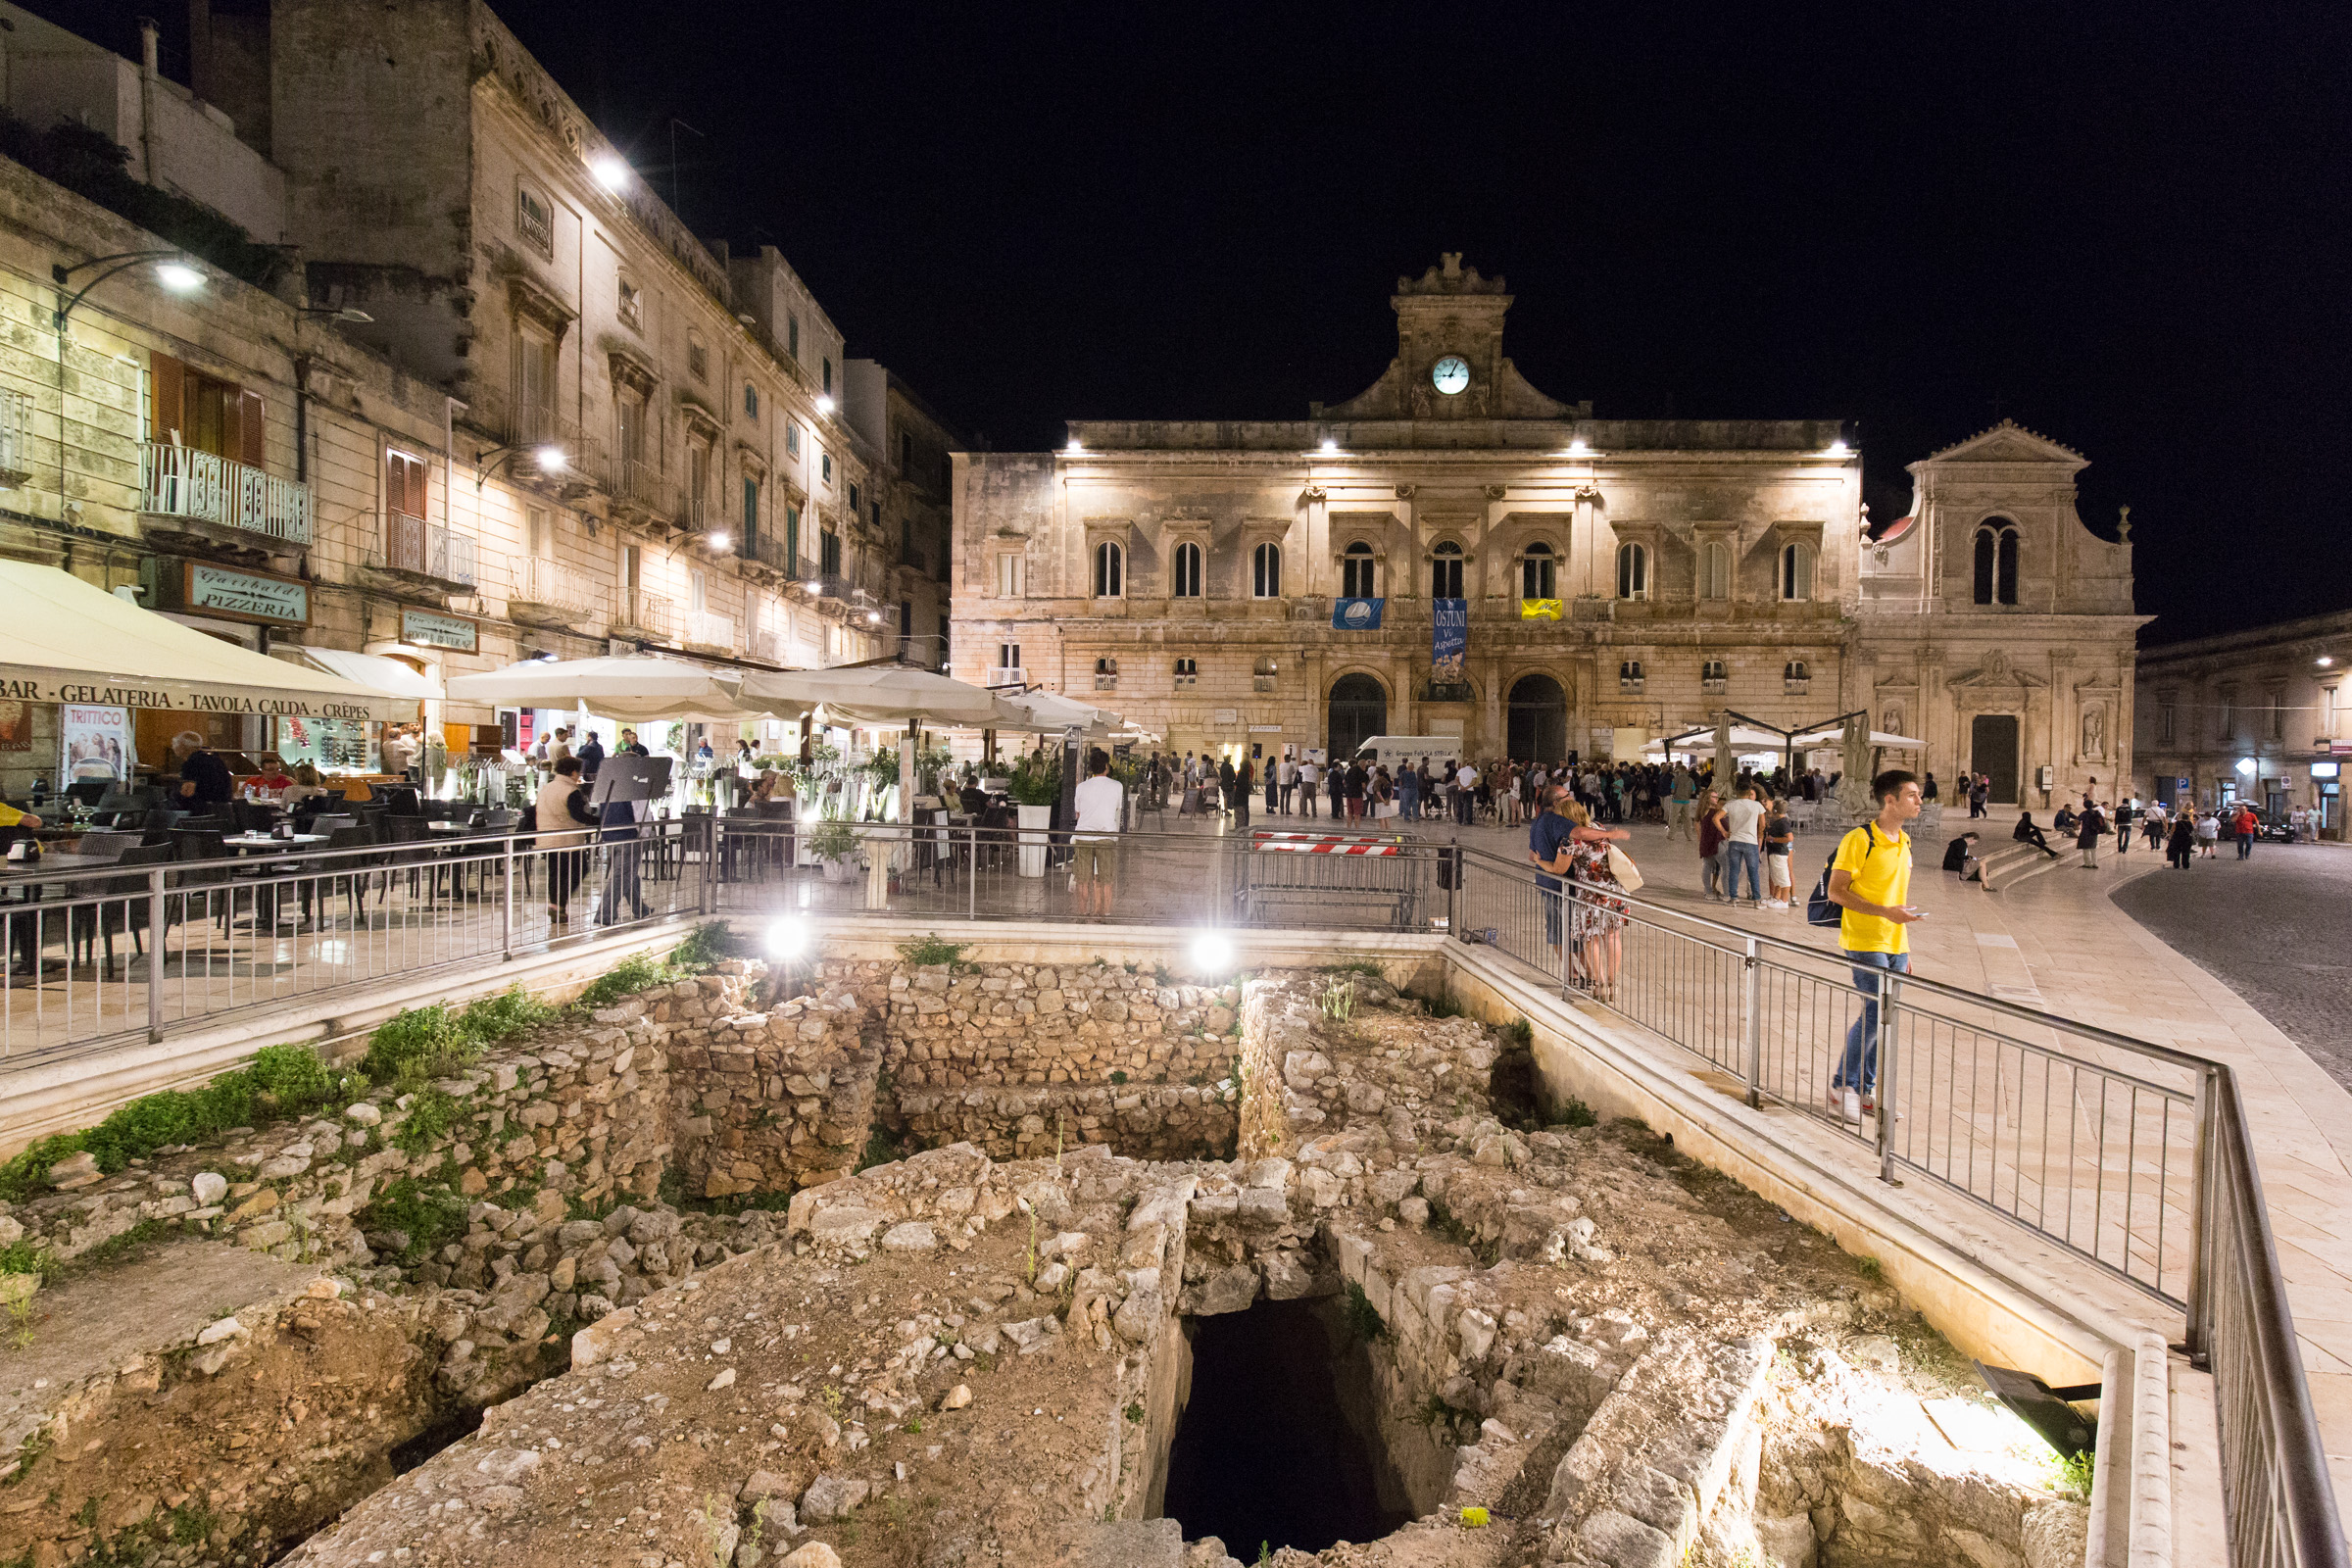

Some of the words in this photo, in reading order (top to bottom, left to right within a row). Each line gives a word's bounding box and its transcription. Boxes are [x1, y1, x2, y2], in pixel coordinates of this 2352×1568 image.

[201, 569, 300, 597] Garibaldi
[203, 593, 297, 618] PIZZERIA
[1436, 610, 1465, 627] OSTUNI
[1434, 637, 1465, 652] Aspetta
[60, 684, 172, 709] GELATERIA
[189, 694, 254, 712] TAVOLA
[258, 699, 310, 715] CALDA
[322, 701, 370, 719] CRÊPES
[70, 709, 122, 726] TRITTICO
